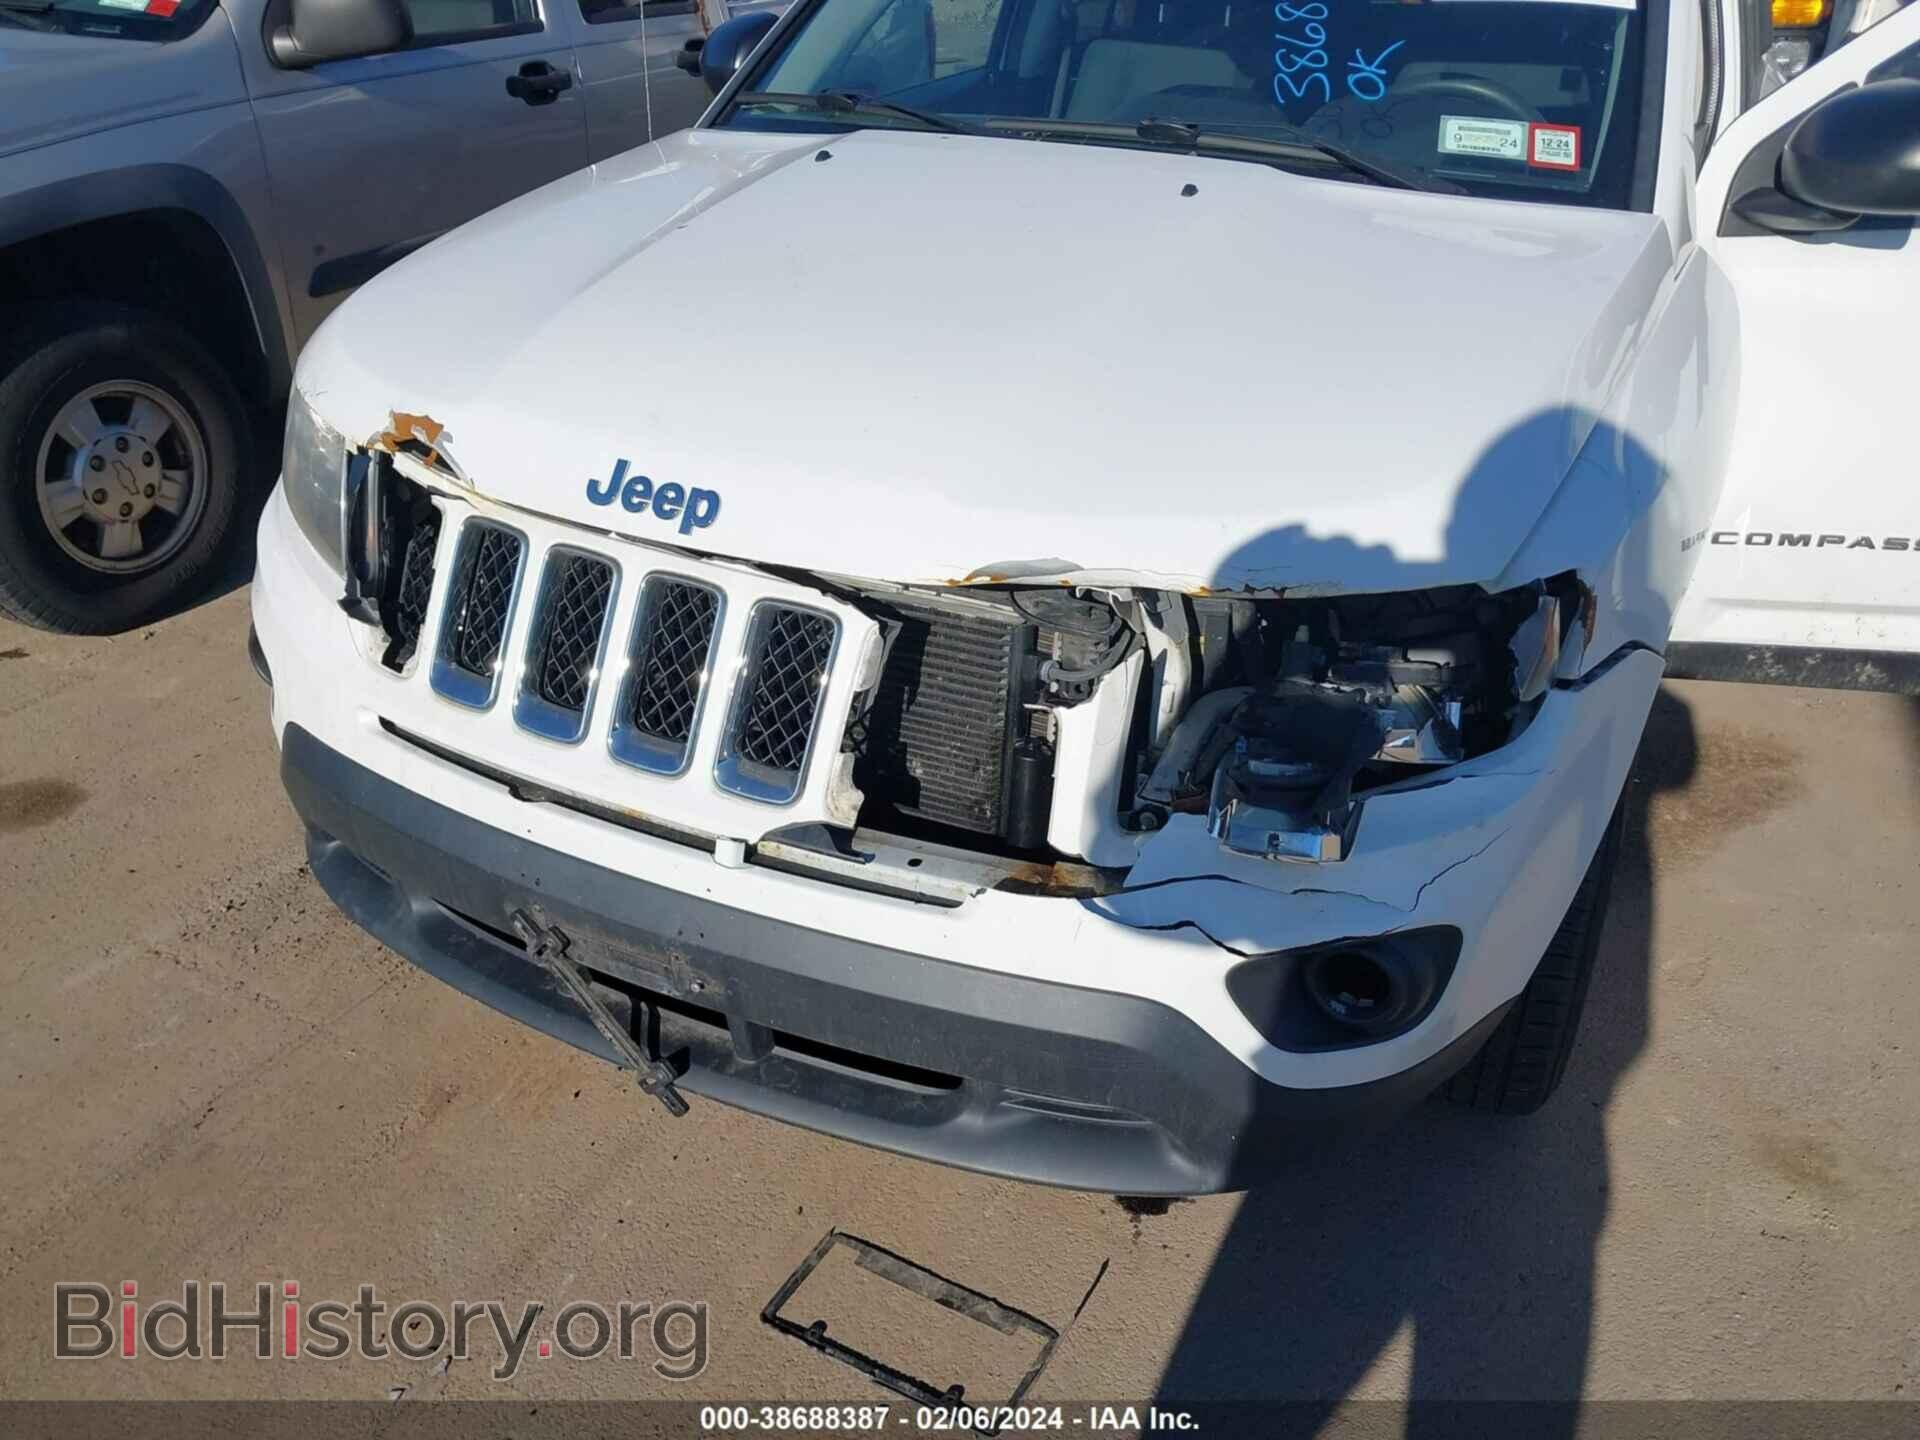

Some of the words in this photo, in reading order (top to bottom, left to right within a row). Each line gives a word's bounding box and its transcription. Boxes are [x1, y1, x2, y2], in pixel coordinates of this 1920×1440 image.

[1347, 39, 1407, 100] OK
[1499, 137, 1518, 149] 24
[586, 458, 721, 536] Jeep
